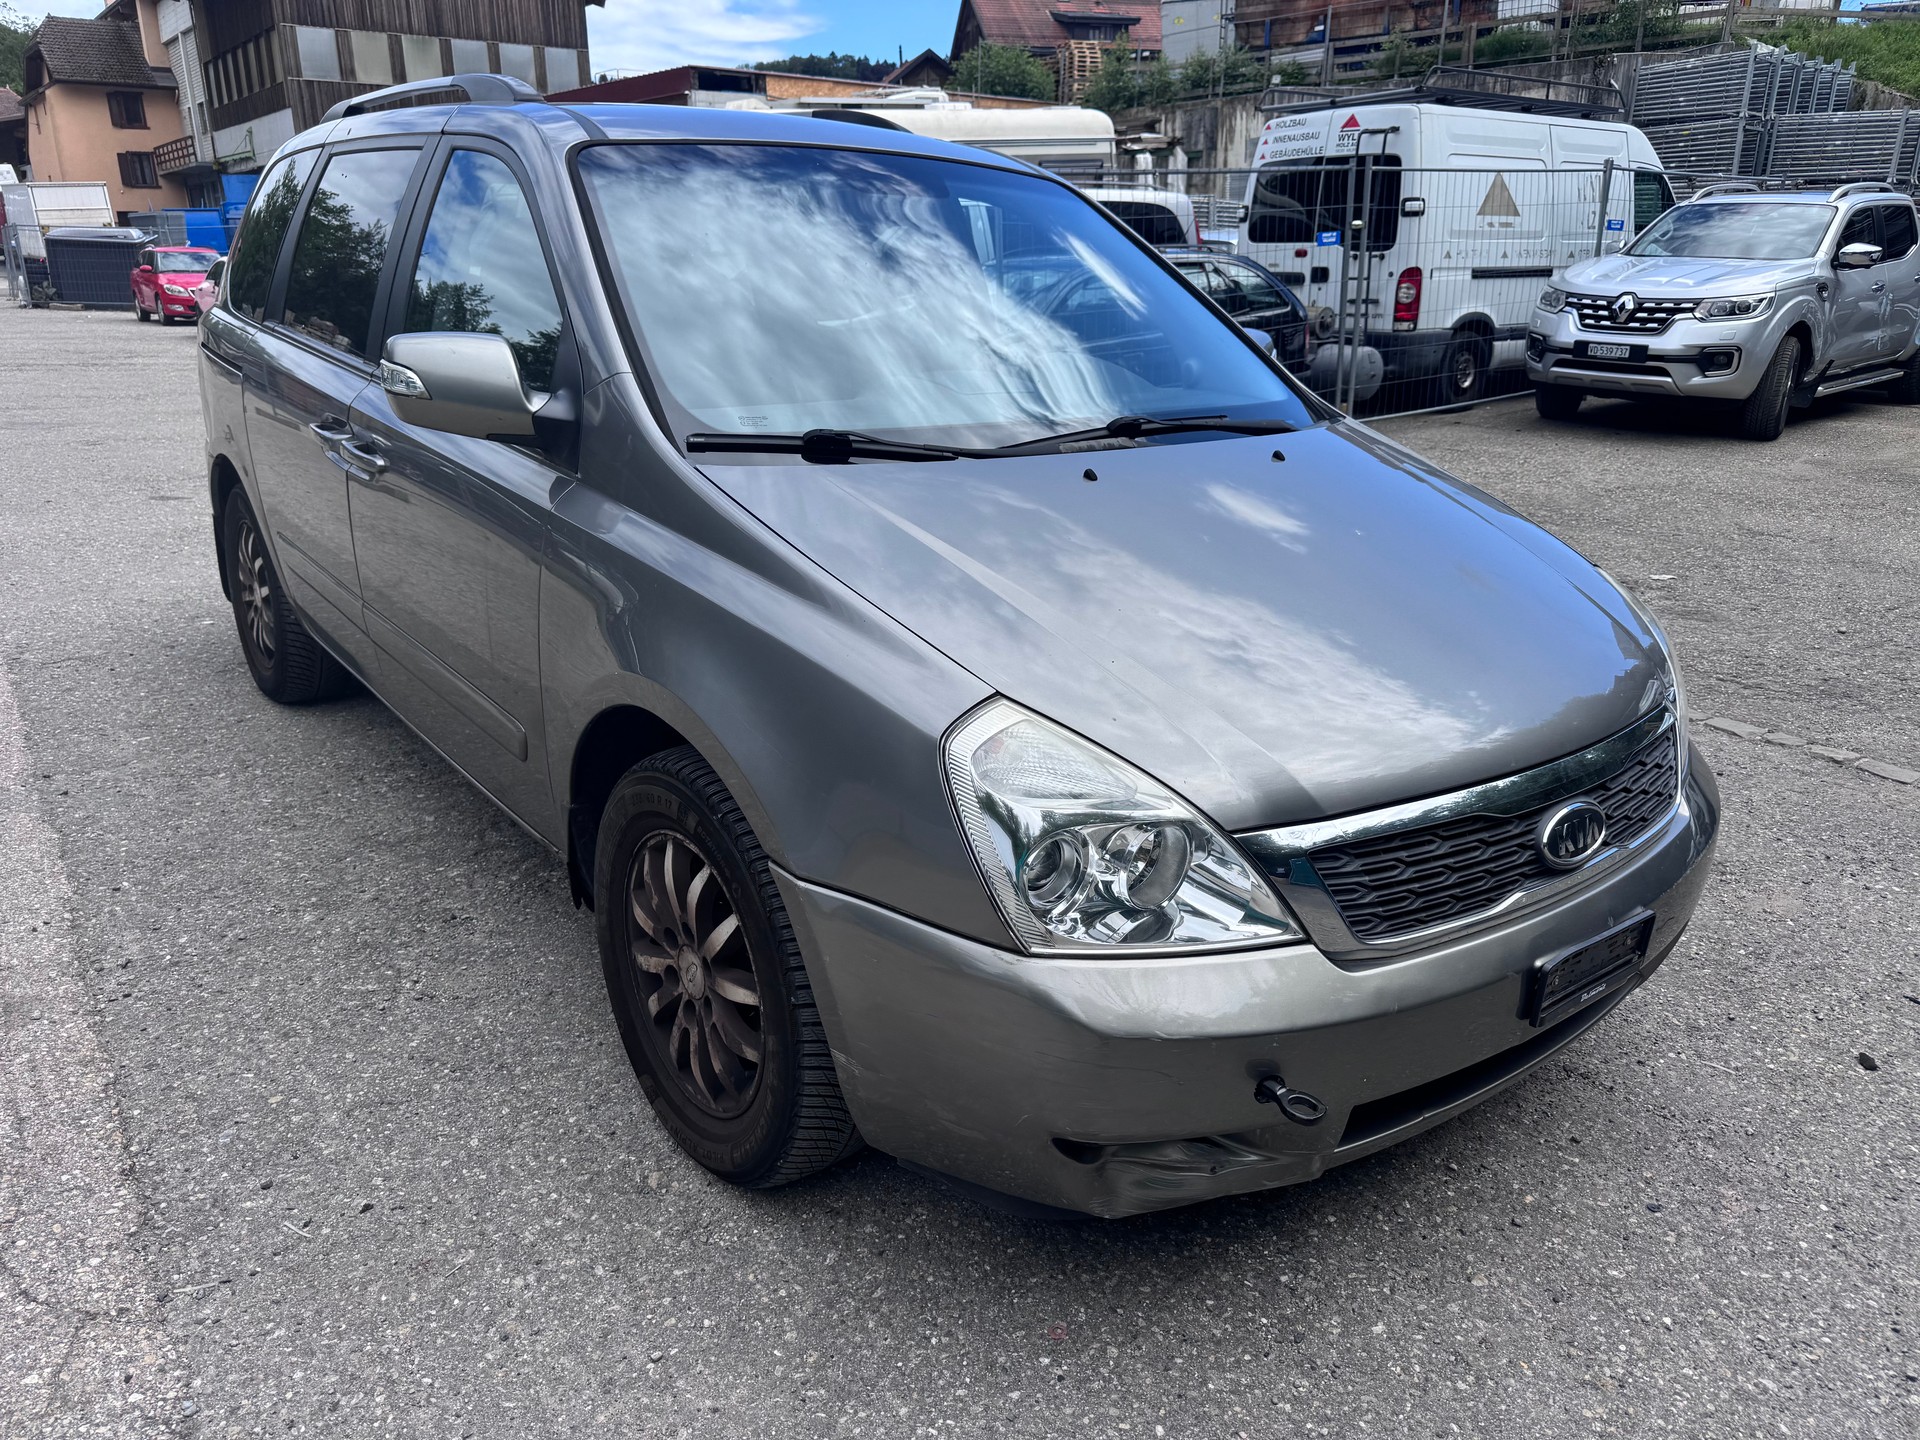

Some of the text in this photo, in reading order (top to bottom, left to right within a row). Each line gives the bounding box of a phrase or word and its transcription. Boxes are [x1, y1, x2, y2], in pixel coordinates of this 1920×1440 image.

[1274, 118, 1307, 129] HOLZBAU
[1271, 131, 1320, 145] INNENAUSBAU
[1269, 146, 1324, 160] GEBÄUDEHÜLLE
